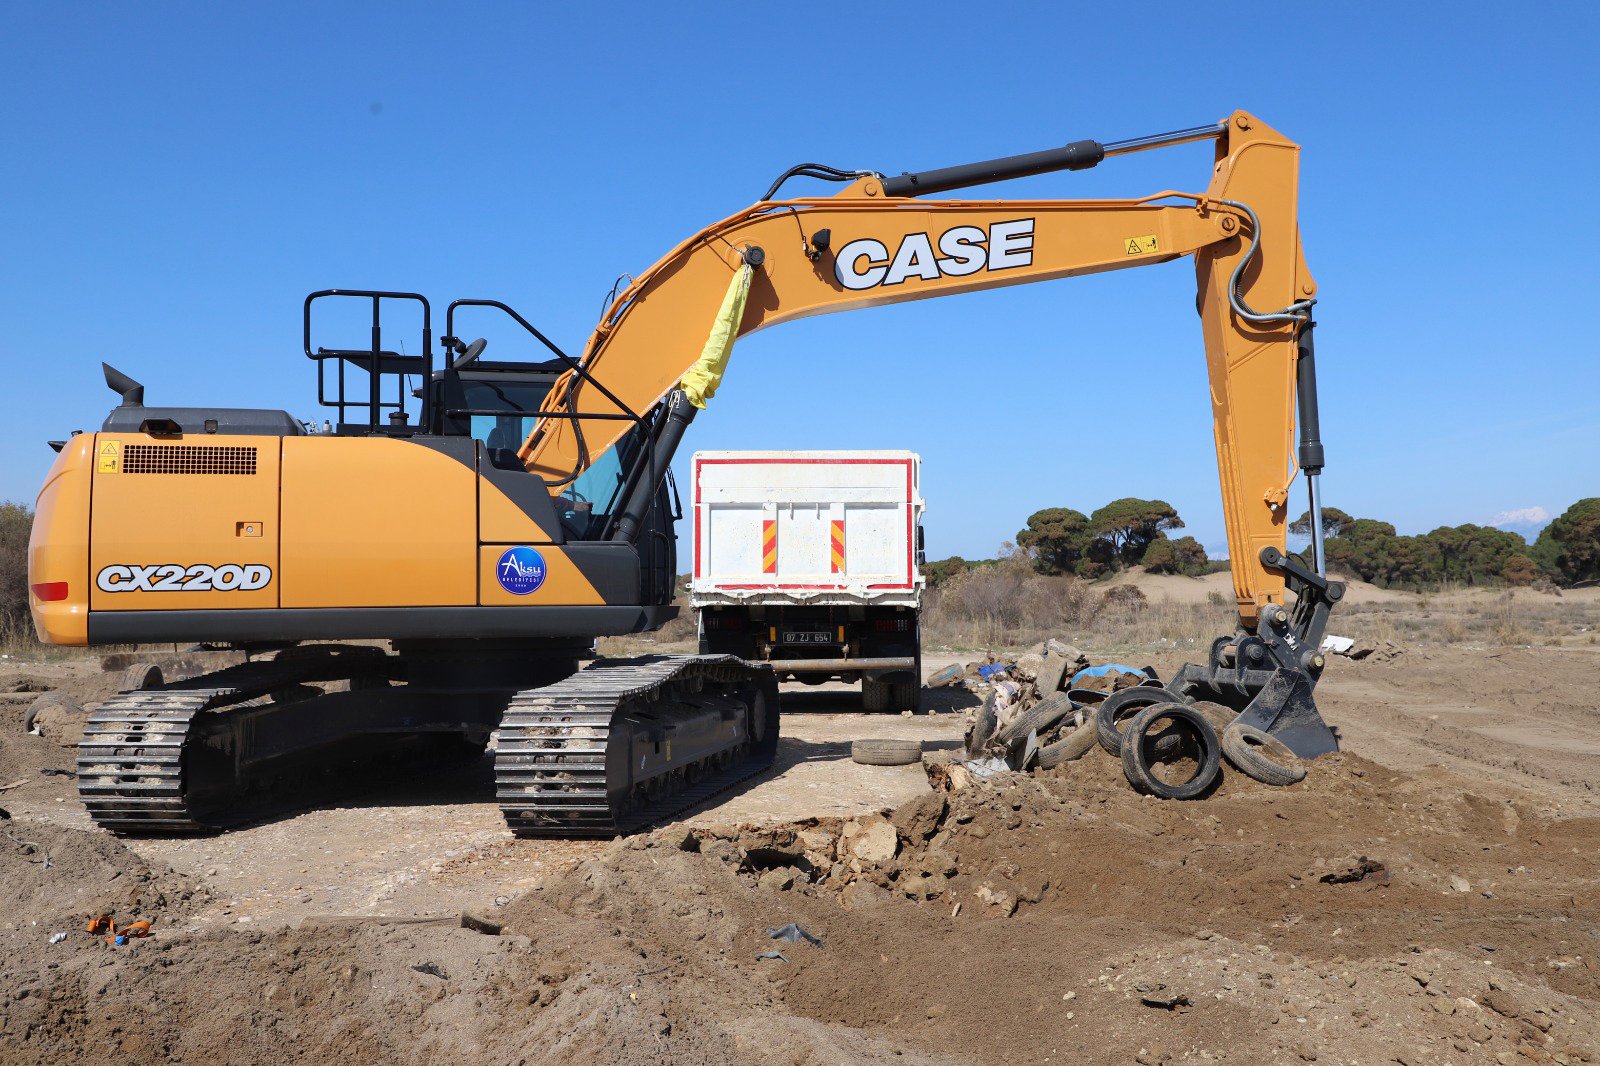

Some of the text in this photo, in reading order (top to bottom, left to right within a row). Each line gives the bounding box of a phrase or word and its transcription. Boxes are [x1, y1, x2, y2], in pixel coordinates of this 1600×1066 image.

[833, 217, 1035, 290] CASE
[96, 564, 272, 593] CX220D
[786, 633, 828, 642] 07 ZJ 654
